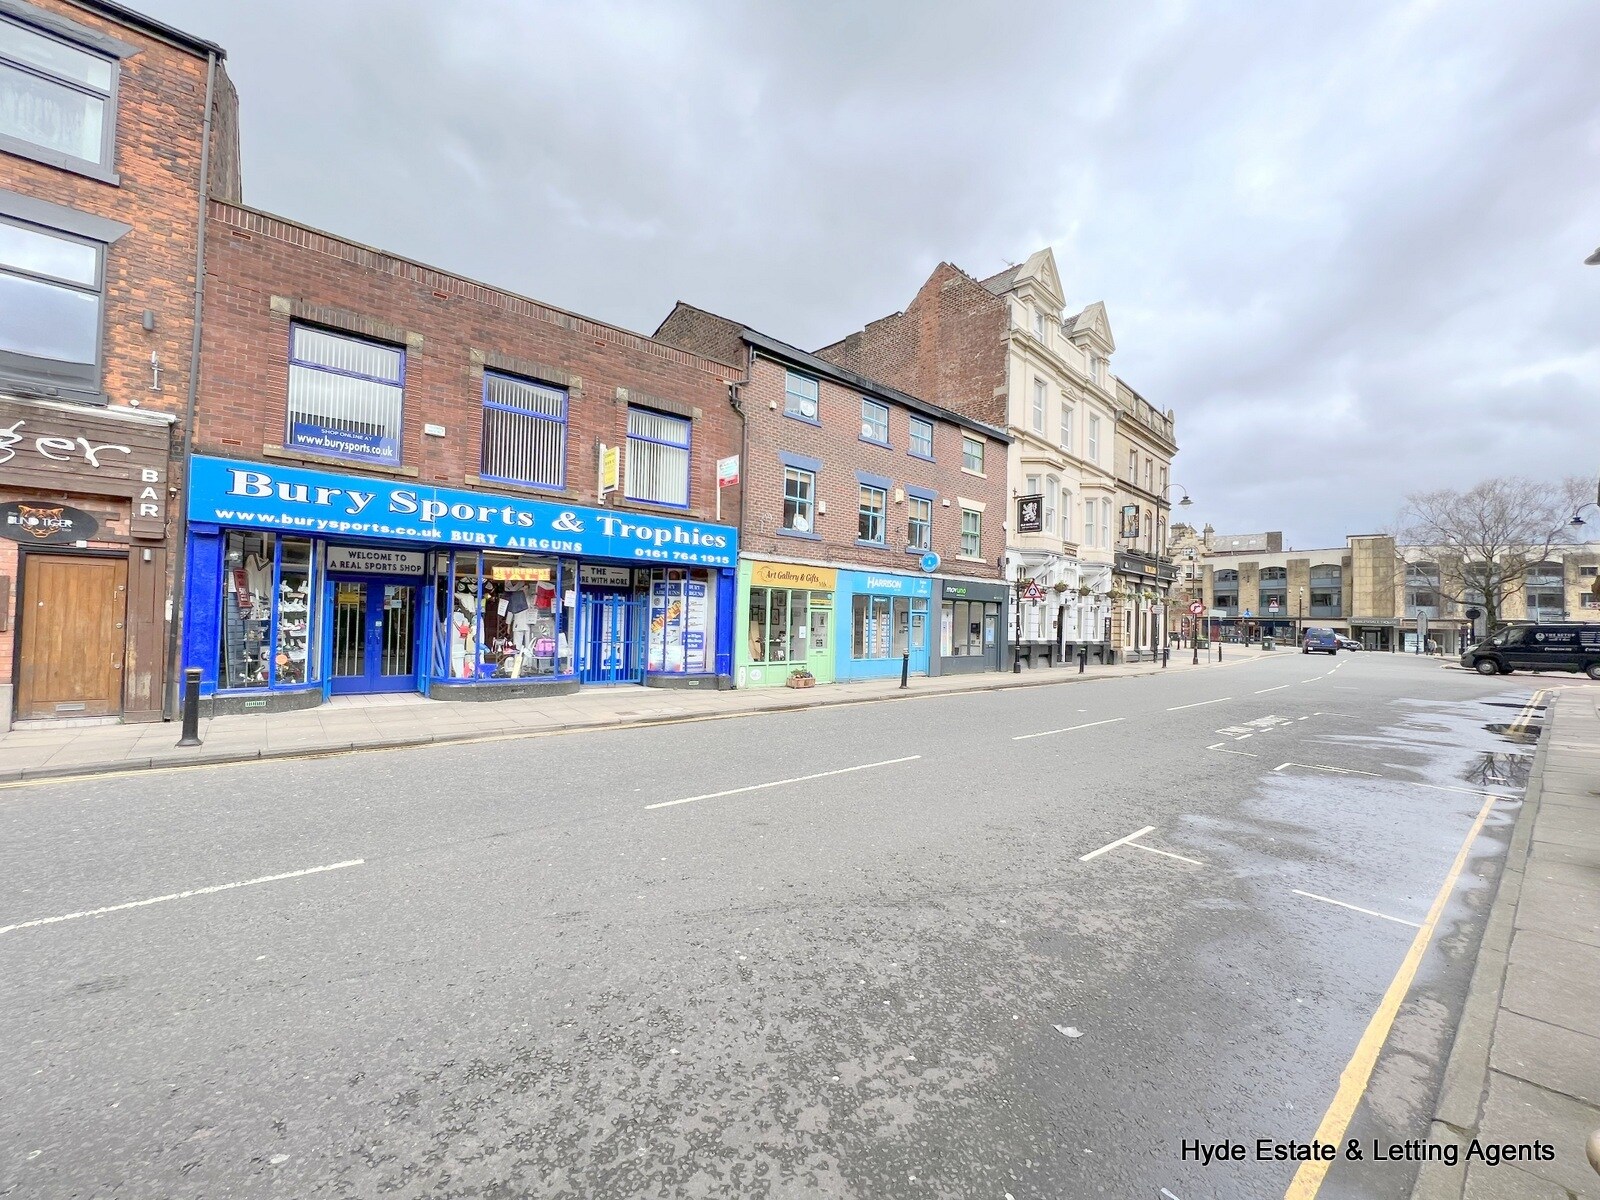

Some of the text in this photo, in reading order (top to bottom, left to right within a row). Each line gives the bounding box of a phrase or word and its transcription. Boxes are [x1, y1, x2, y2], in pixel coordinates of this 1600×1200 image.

[340, 431, 363, 441] ONLINE
[297, 434, 393, 457] www.burysports.co.uk
[140, 469, 159, 518] BAR
[226, 468, 727, 548] Bury Sports & Trophies
[214, 509, 583, 552] www.burysports.co.uk BURY AIRGUNS
[348, 551, 392, 560] WELCOME
[635, 548, 730, 564] 0161 764 1915
[330, 560, 421, 572] A REAL SPORTS SHOP
[591, 567, 606, 575] THE
[777, 570, 799, 582] Gallery
[806, 573, 819, 583] Gifts
[867, 576, 902, 589] HARRISON
